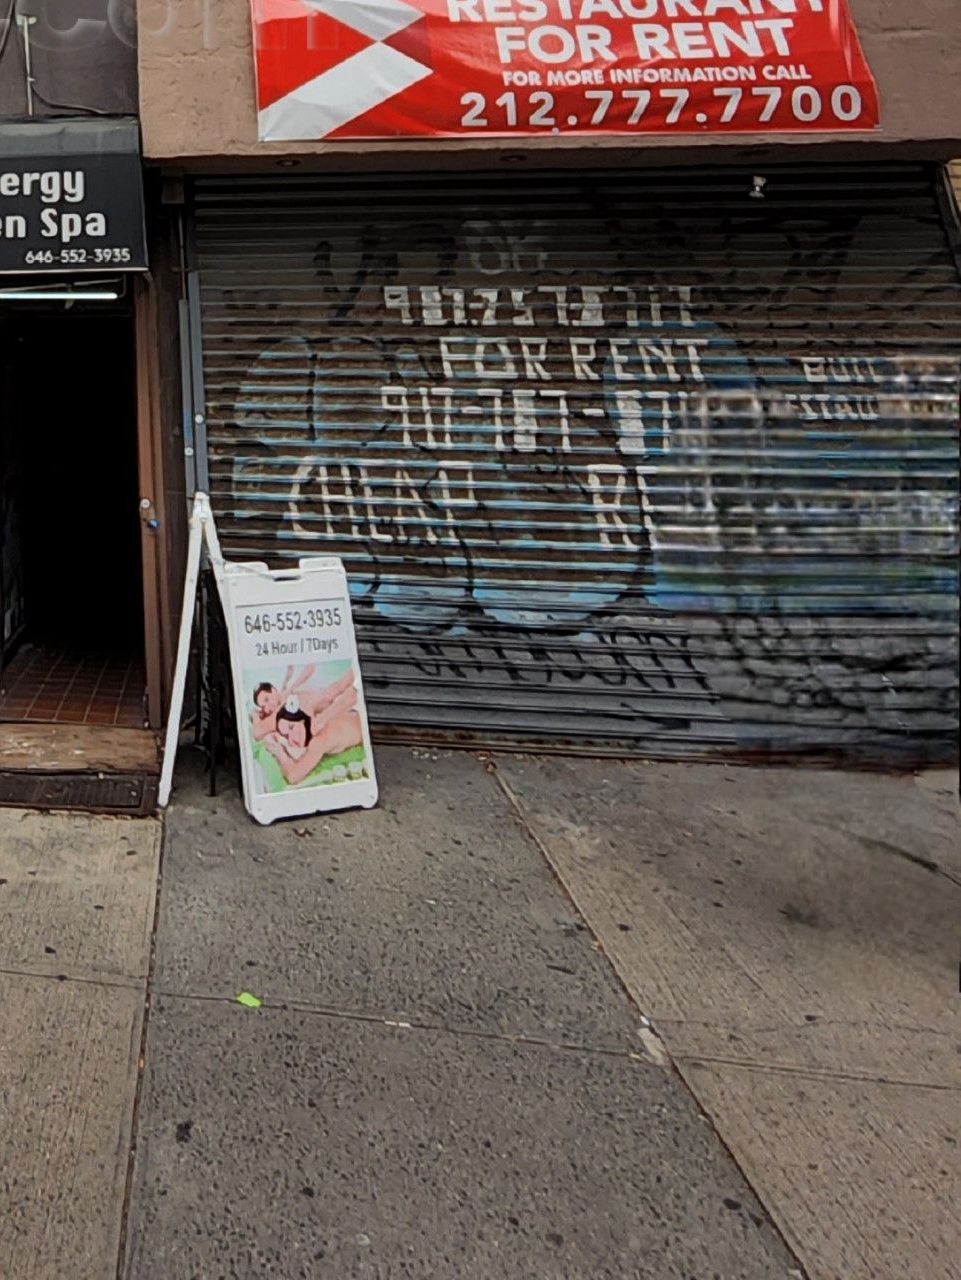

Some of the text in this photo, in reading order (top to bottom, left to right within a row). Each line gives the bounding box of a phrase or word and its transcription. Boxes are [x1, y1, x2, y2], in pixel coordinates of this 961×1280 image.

[495, 19, 794, 63] FOR RENT
[503, 64, 812, 86] FOR MORE INFORMATION CALL
[459, 84, 863, 127] 212.777.7700
[40, 208, 107, 243] Spa
[24, 248, 131, 265] 646-552-3935
[255, 642, 269, 657] 24
[271, 641, 297, 655] Hour
